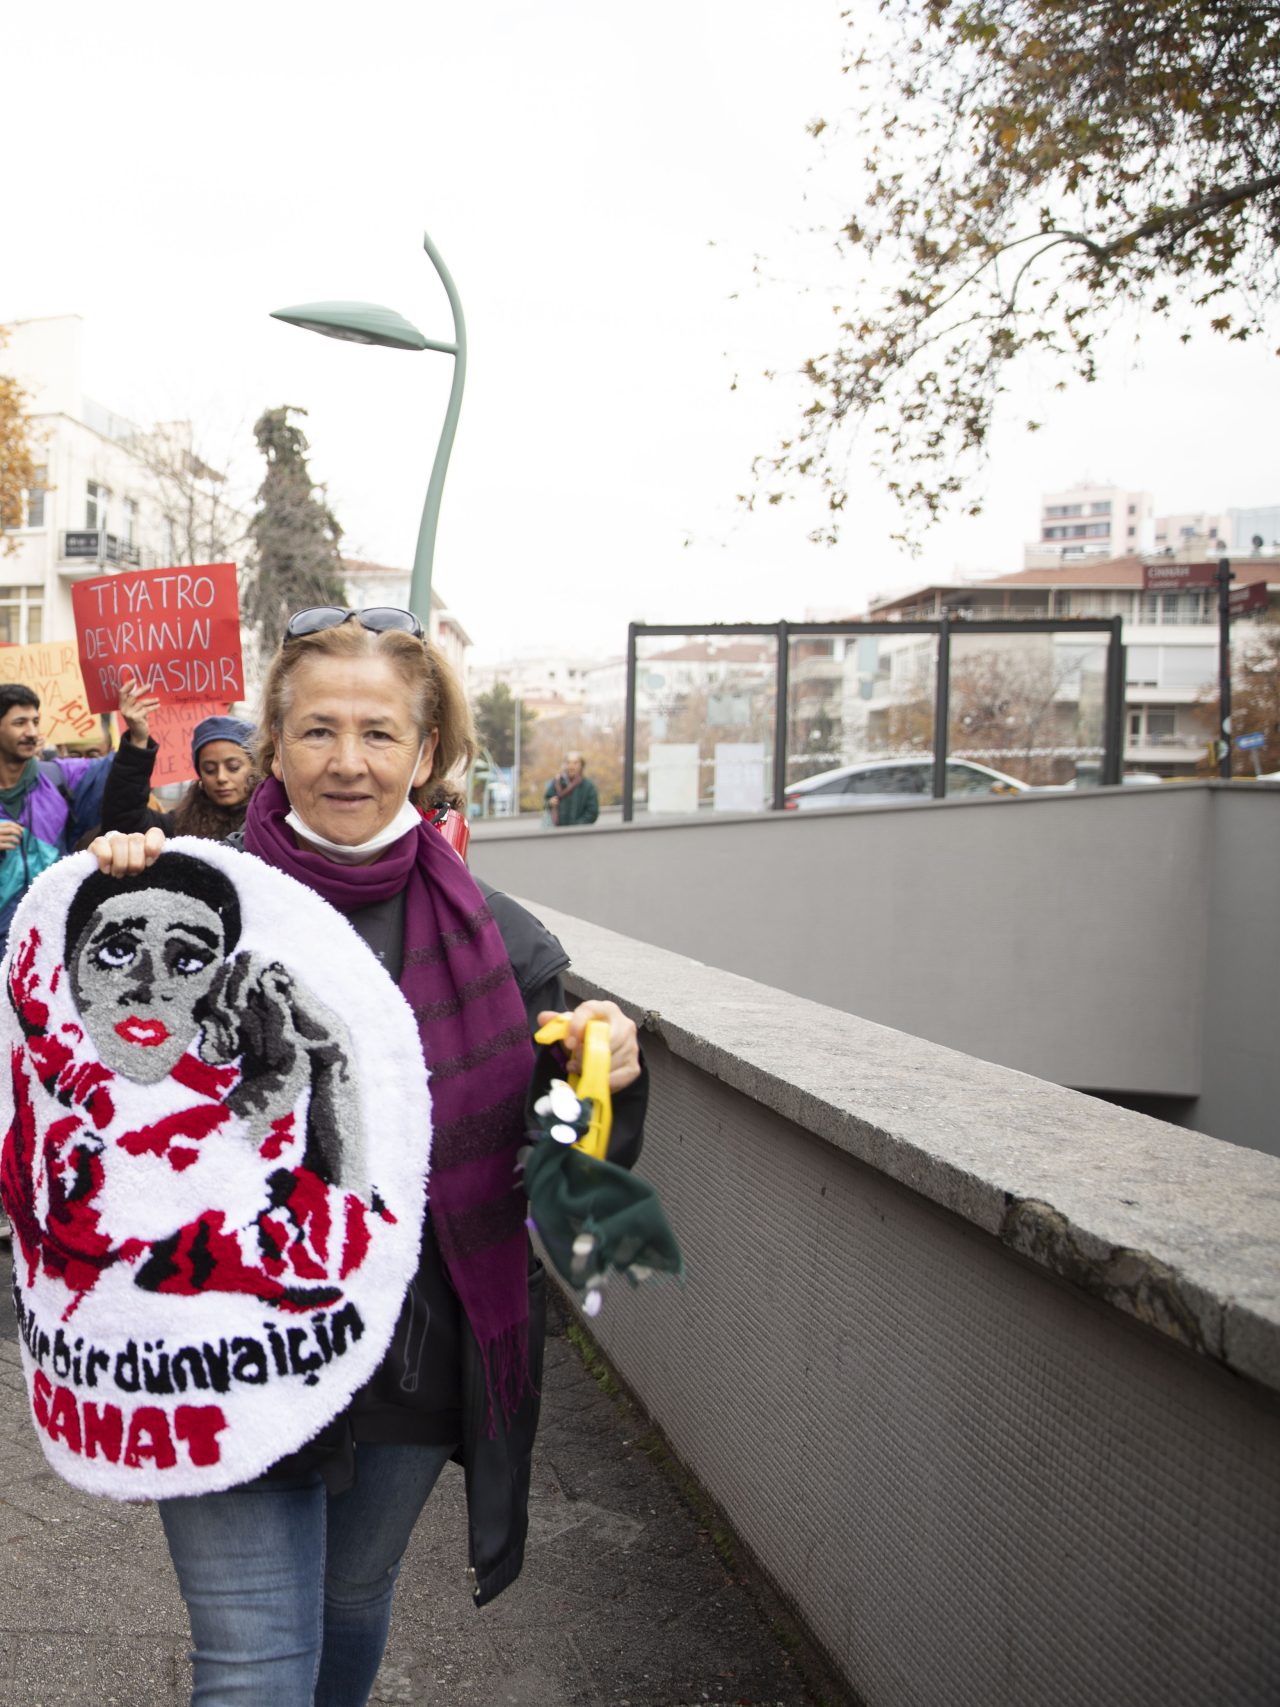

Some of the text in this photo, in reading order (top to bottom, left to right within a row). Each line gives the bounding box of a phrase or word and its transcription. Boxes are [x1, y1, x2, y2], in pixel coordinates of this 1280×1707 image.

[89, 574, 216, 617] TİYATRO
[84, 617, 211, 660] DEVRİMİN
[98, 656, 239, 700] PROVASIDIR
[33, 1369, 229, 1470] SANAT
